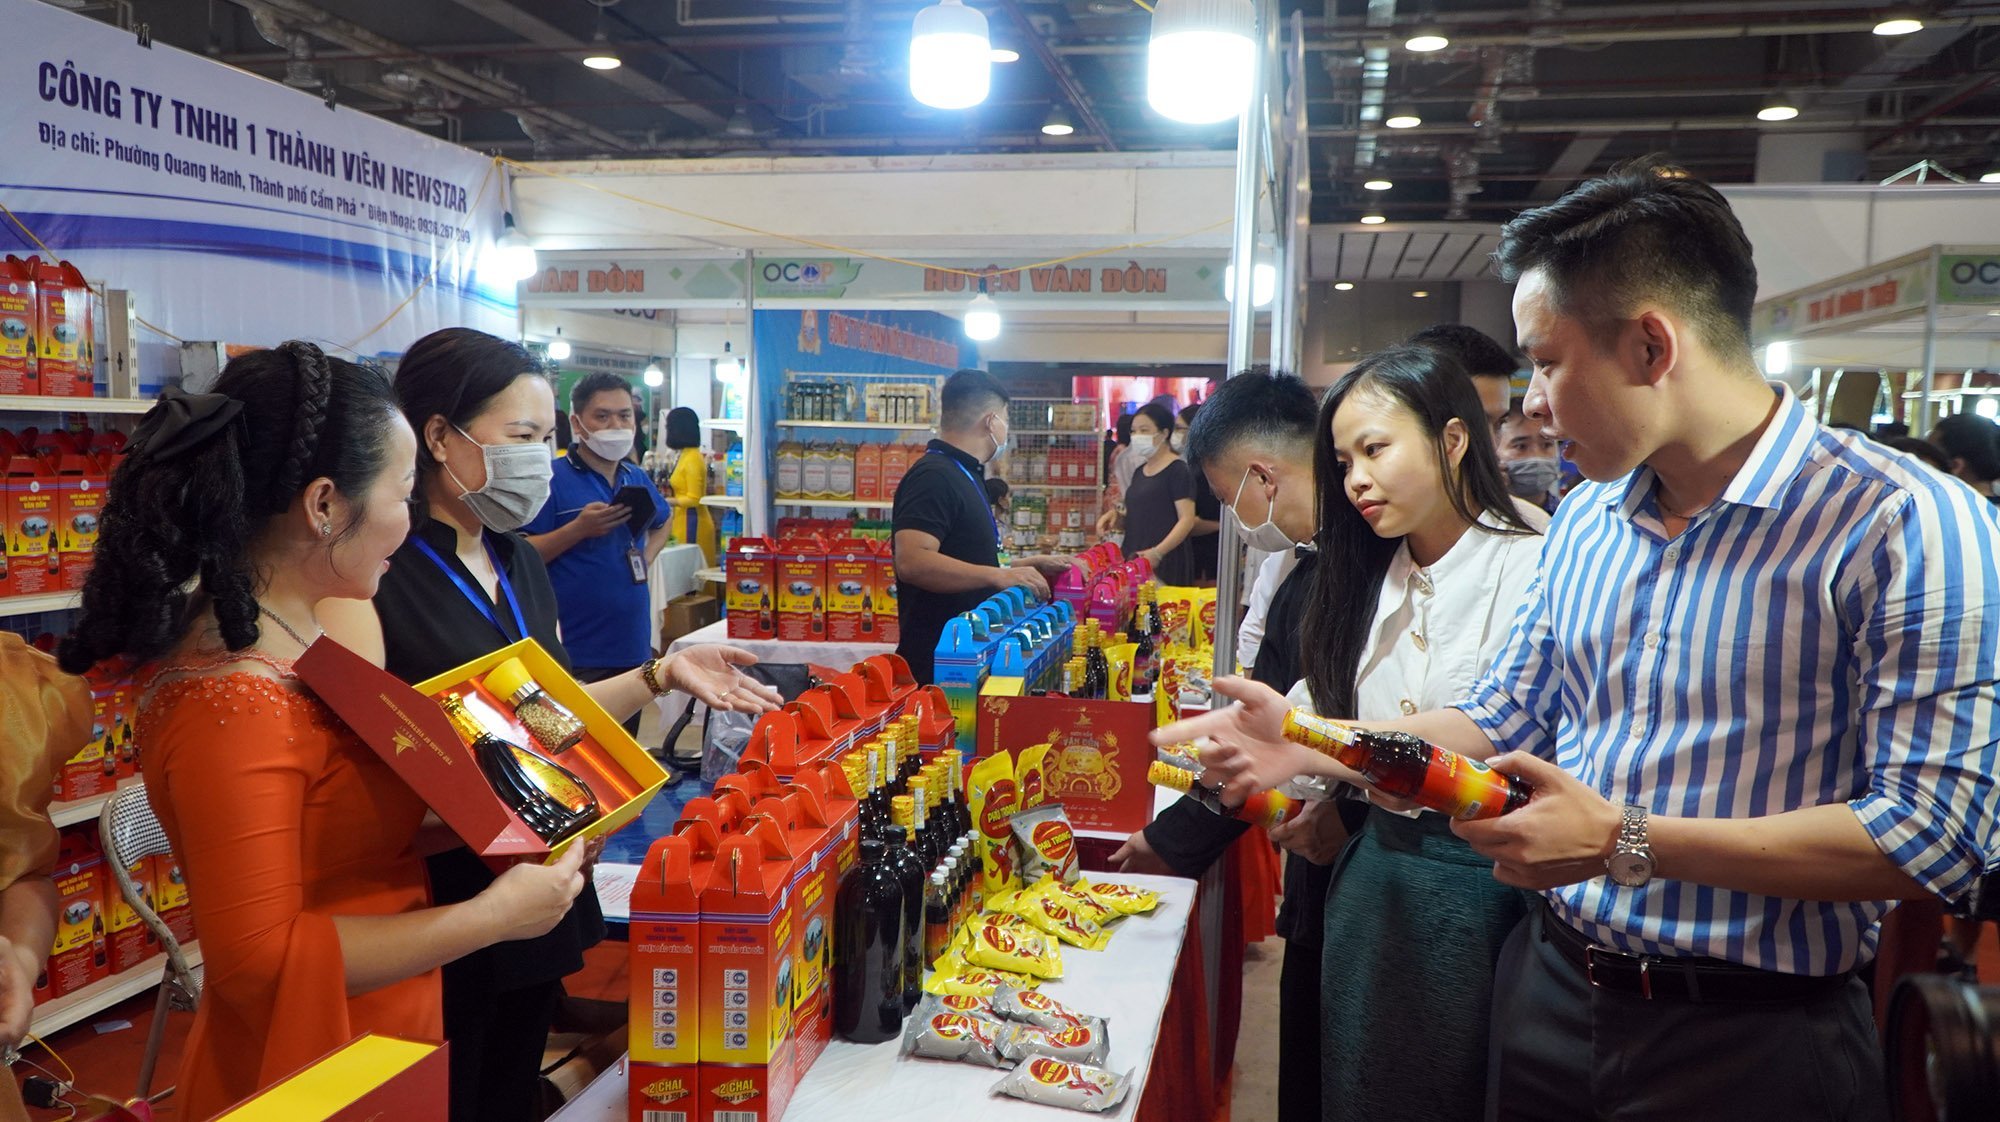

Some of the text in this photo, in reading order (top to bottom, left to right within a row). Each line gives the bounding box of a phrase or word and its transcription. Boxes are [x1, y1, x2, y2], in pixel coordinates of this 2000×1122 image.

[38, 60, 467, 214] CÔNG TY TNHH 1 THÀNH VIÊN NEWSTAR
[39, 122, 66, 150] Địa
[71, 132, 100, 155] chỉ:
[105, 138, 159, 172] Phường
[164, 152, 206, 182] Quang
[210, 164, 246, 192] Hanh,
[249, 174, 284, 199] Thành
[287, 185, 307, 205] phố
[310, 188, 333, 211] Cẩm
[337, 196, 357, 216] Phả
[368, 204, 387, 225] Điện
[390, 211, 416, 232] thoại:
[586, 262, 645, 293] ĐỒN
[763, 262, 836, 283] OCOP
[924, 260, 1167, 296] HUYỆN VÂN ĐỒN
[649, 1079, 682, 1094] 2 CHAI
[720, 1079, 753, 1094] 2 CHAI
